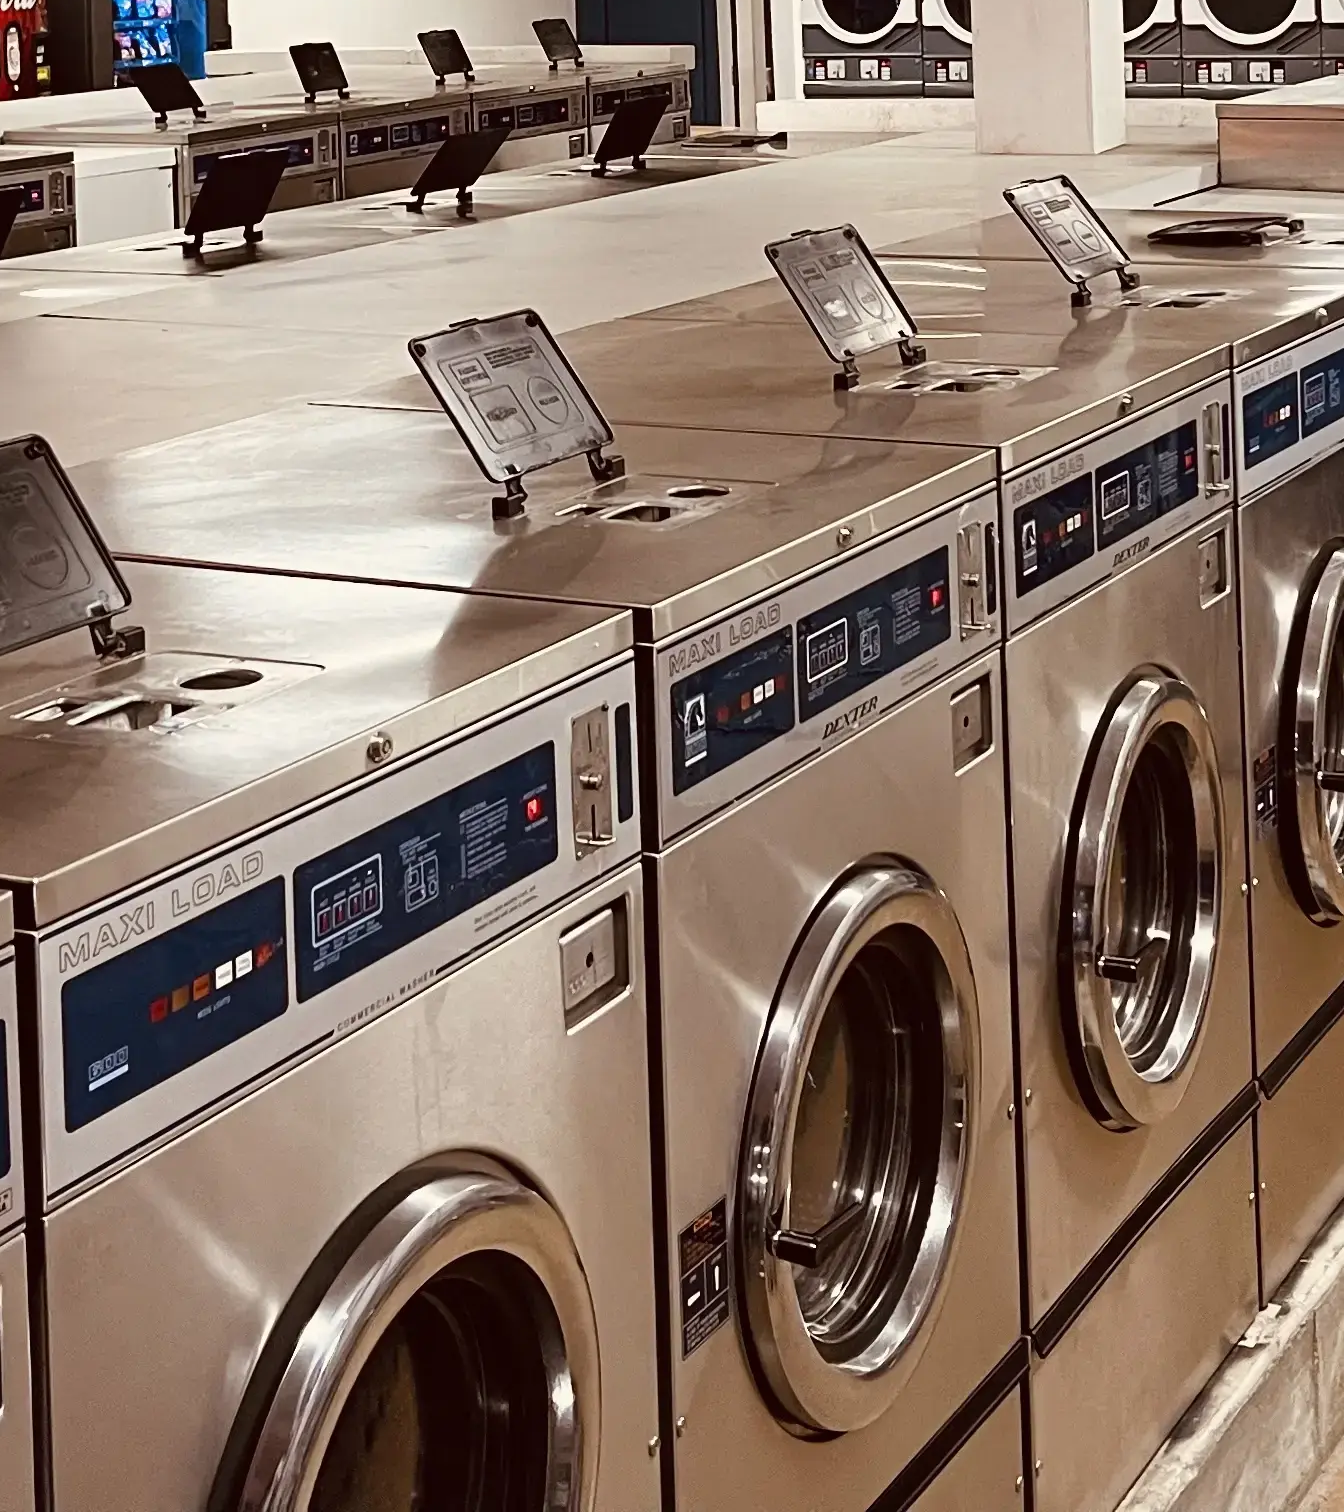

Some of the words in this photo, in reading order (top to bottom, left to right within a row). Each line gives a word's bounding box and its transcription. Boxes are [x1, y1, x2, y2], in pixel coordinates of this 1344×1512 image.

[668, 632, 721, 677] MAXI
[729, 603, 781, 646] LOAD
[821, 695, 878, 740] DEXTER
[59, 901, 155, 973] MAXI
[171, 850, 263, 918] LOAD
[337, 994, 395, 1032] COMMERCIAL
[399, 968, 436, 996] WASHER
